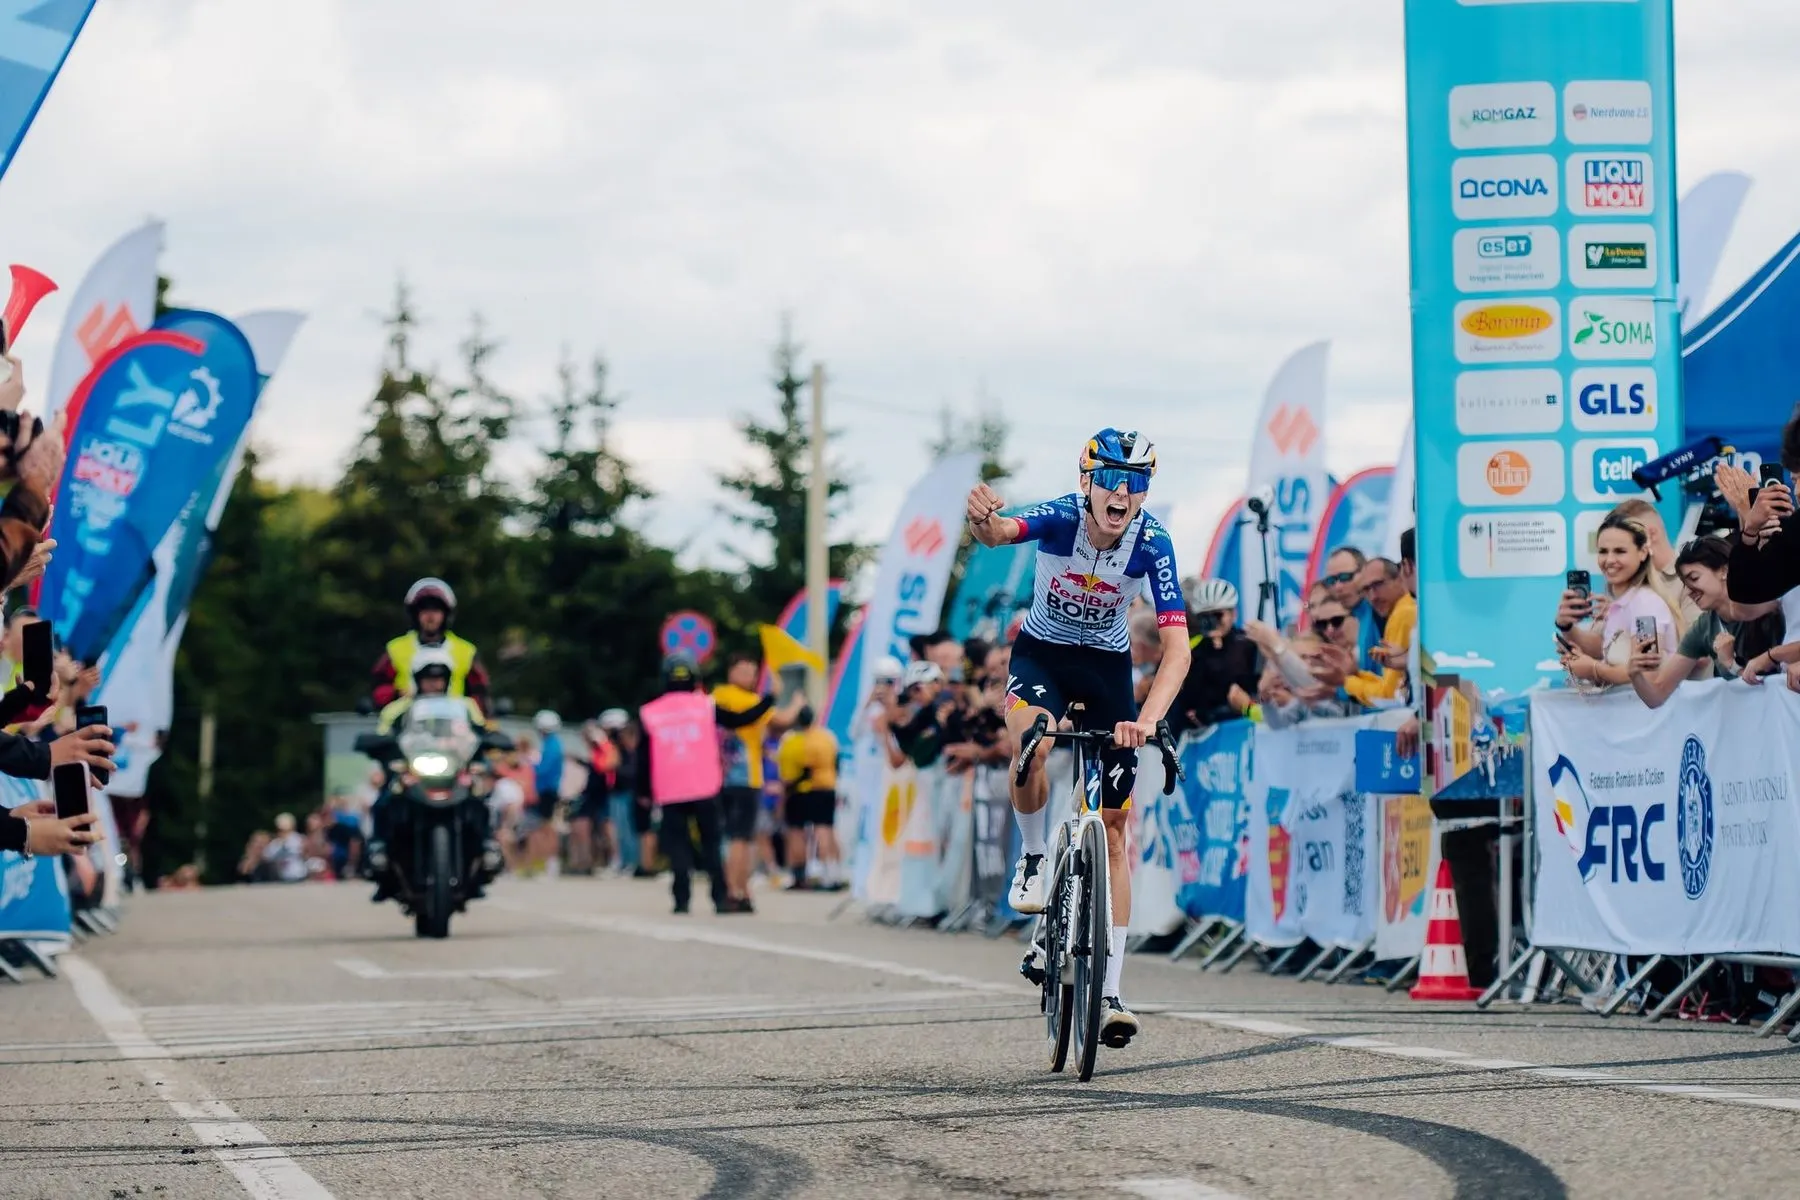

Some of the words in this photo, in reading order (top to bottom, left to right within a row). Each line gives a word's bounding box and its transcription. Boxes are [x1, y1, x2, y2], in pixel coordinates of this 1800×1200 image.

[1472, 106, 1537, 121] ROMGAZ
[1586, 161, 1643, 183] LIQUI
[1587, 184, 1644, 206] MOLY
[1600, 322, 1653, 344] SOMA
[1019, 503, 1055, 518] OSS
[1155, 555, 1177, 601] BOSS
[1050, 576, 1086, 604] Red
[1087, 594, 1125, 609] Bull
[1047, 591, 1117, 621] BORA
[1584, 803, 1665, 883] FRC
